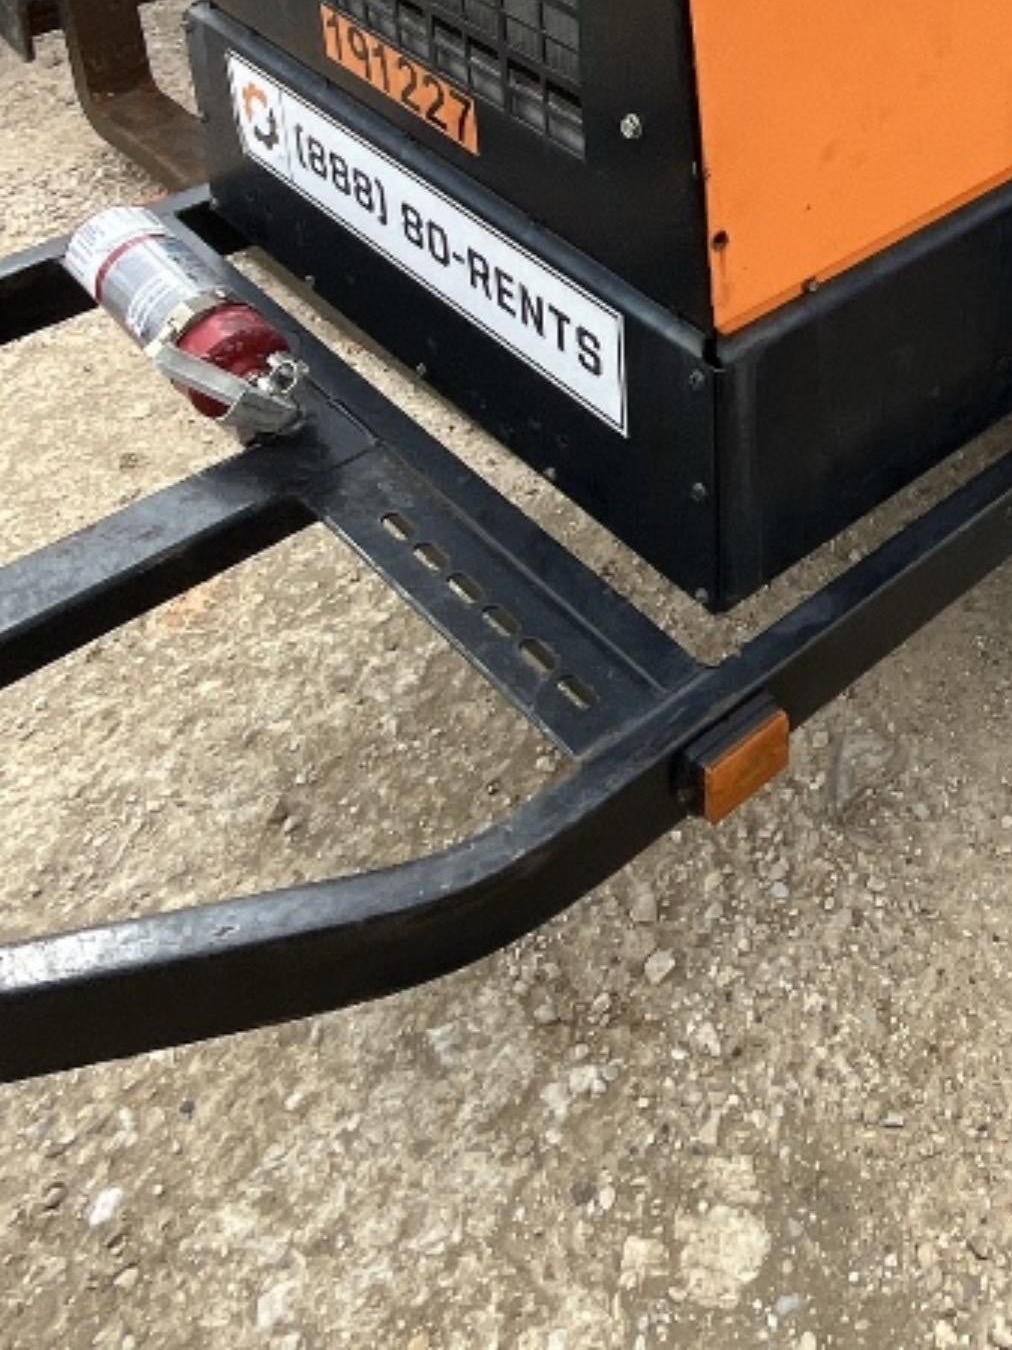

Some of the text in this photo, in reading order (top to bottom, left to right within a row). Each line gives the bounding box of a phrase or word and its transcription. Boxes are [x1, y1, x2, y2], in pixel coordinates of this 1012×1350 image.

[324, 10, 471, 141] 191227
[294, 123, 603, 378] (888) 80-RENTS
